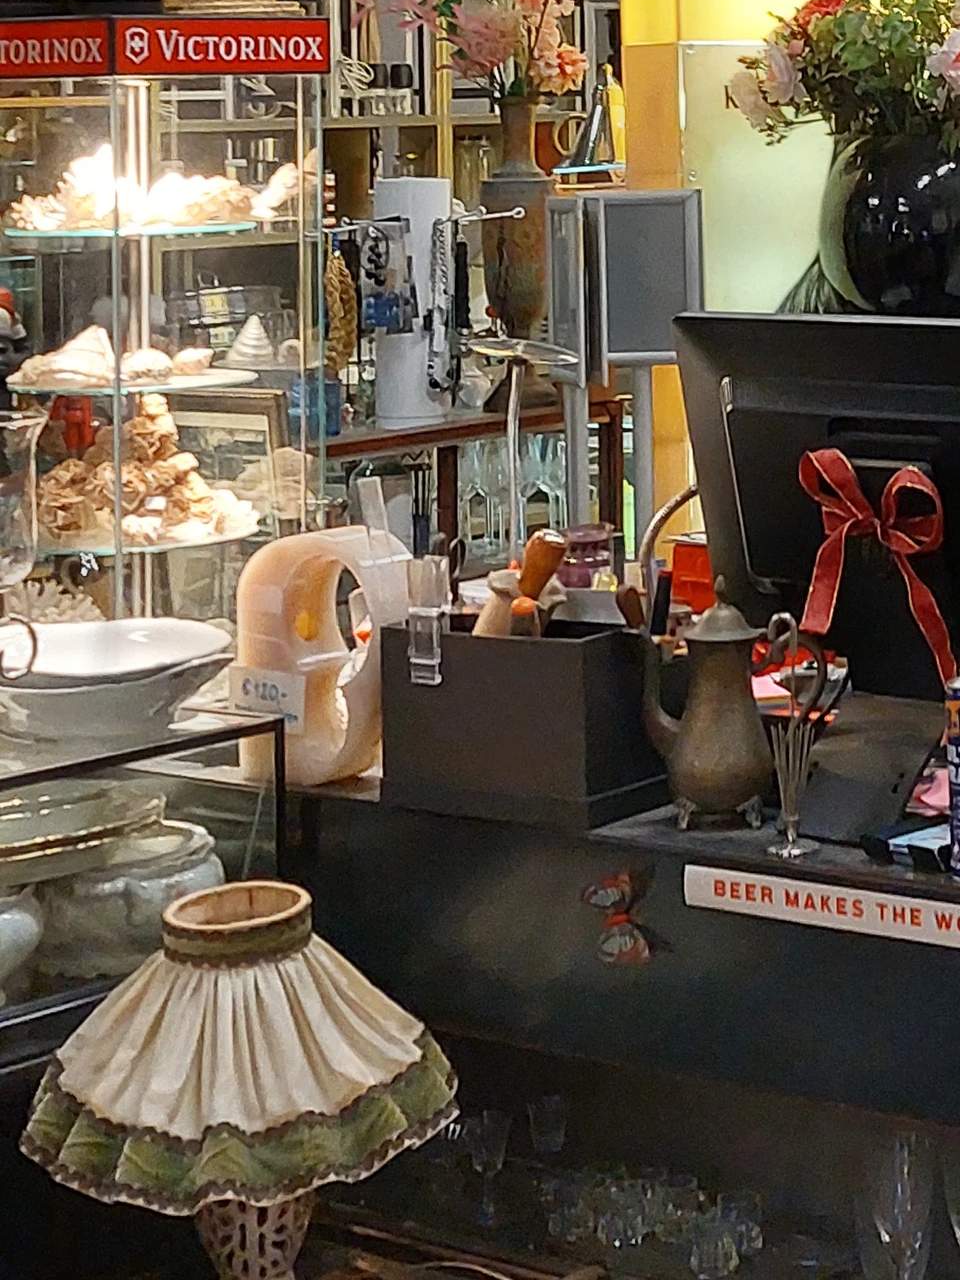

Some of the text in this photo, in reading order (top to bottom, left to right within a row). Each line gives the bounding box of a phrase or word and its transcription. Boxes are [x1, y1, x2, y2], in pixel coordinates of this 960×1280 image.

[156, 29, 323, 61] VICTORINOX
[713, 878, 775, 905] BEER
[784, 888, 865, 918] MAKES
[875, 903, 923, 927] THE
